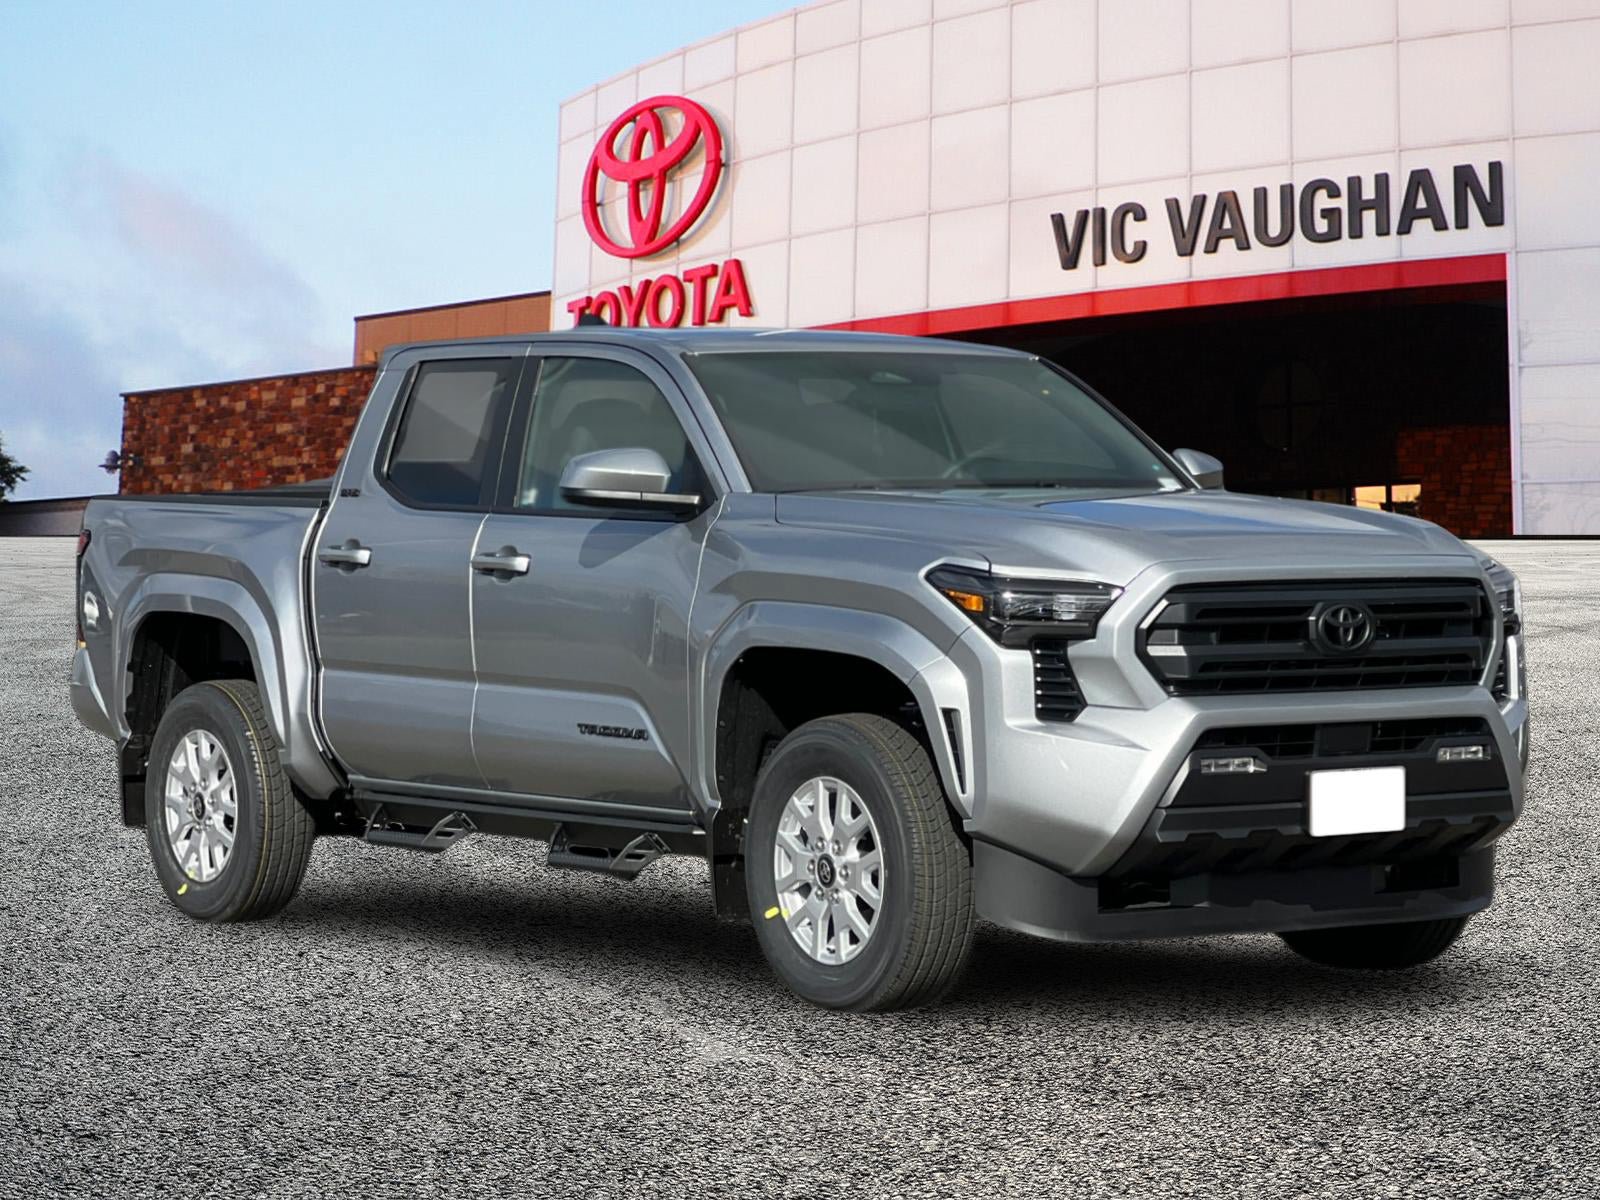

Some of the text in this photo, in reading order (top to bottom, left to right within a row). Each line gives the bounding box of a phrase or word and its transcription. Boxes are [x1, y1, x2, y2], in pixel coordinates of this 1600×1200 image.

[1050, 160, 1505, 270] VIC VAUGHAN
[567, 258, 754, 328] TOYOTA
